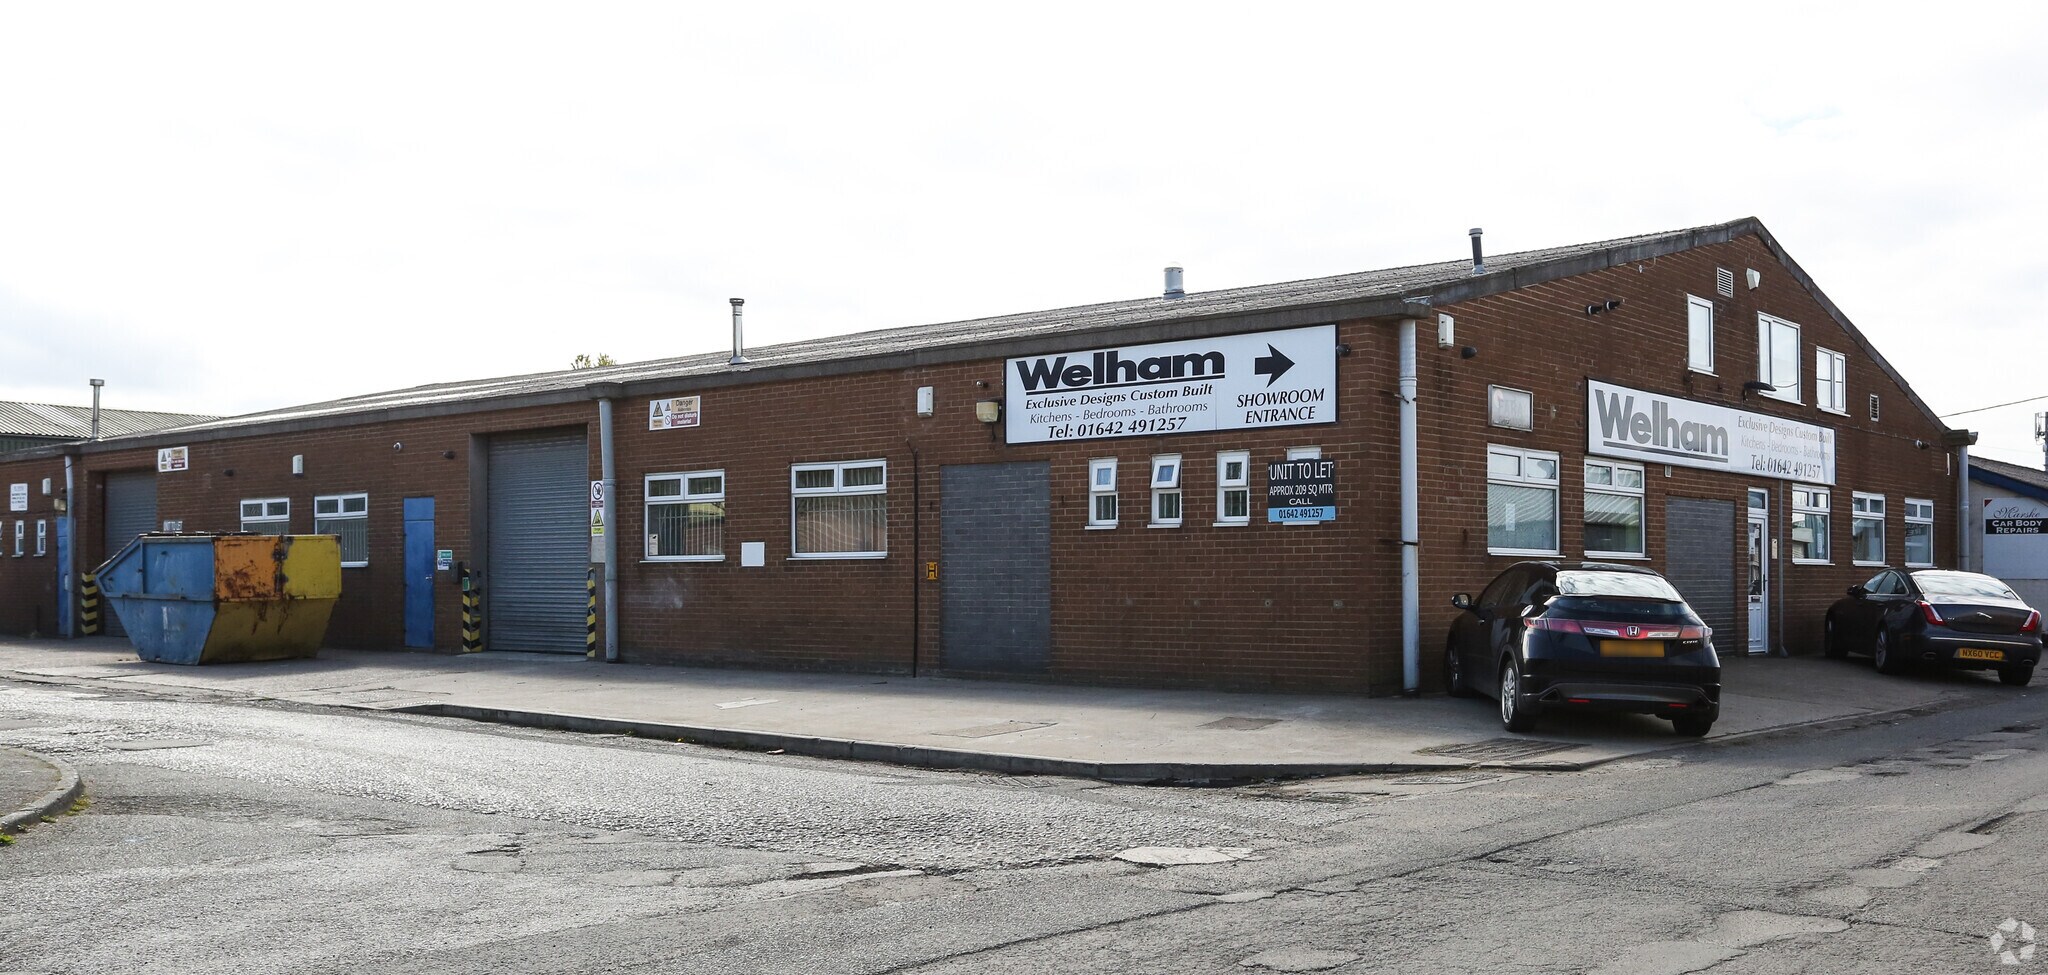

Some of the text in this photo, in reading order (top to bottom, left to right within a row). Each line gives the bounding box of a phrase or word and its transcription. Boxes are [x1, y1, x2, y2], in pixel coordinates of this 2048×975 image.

[1016, 351, 1225, 391] Welham
[1025, 383, 1213, 410] Exclusive Designs Custom Built
[1237, 388, 1325, 409] SHOWROOM
[1029, 411, 1073, 424] Kitchens
[1082, 406, 1136, 420] Bedrooms
[1147, 402, 1208, 415] Bathrooms
[1245, 406, 1316, 424] ENTRANCE
[1595, 389, 1728, 456] Welham
[1048, 416, 1187, 439] Tel: 01642 491257
[1738, 415, 1833, 444] Exclusive Designs Custom Built
[1741, 434, 1766, 451] Kitchens
[1771, 439, 1799, 456] Bedrooms
[1297, 462, 1312, 479] TO
[1751, 454, 1821, 479] Tel: 01642 491257
[1269, 483, 1334, 497] APPROX 209 SQ MTR
[1288, 498, 1313, 506] CALL
[1278, 508, 1324, 519] 01642 491257
[1962, 649, 1983, 658] NX60
